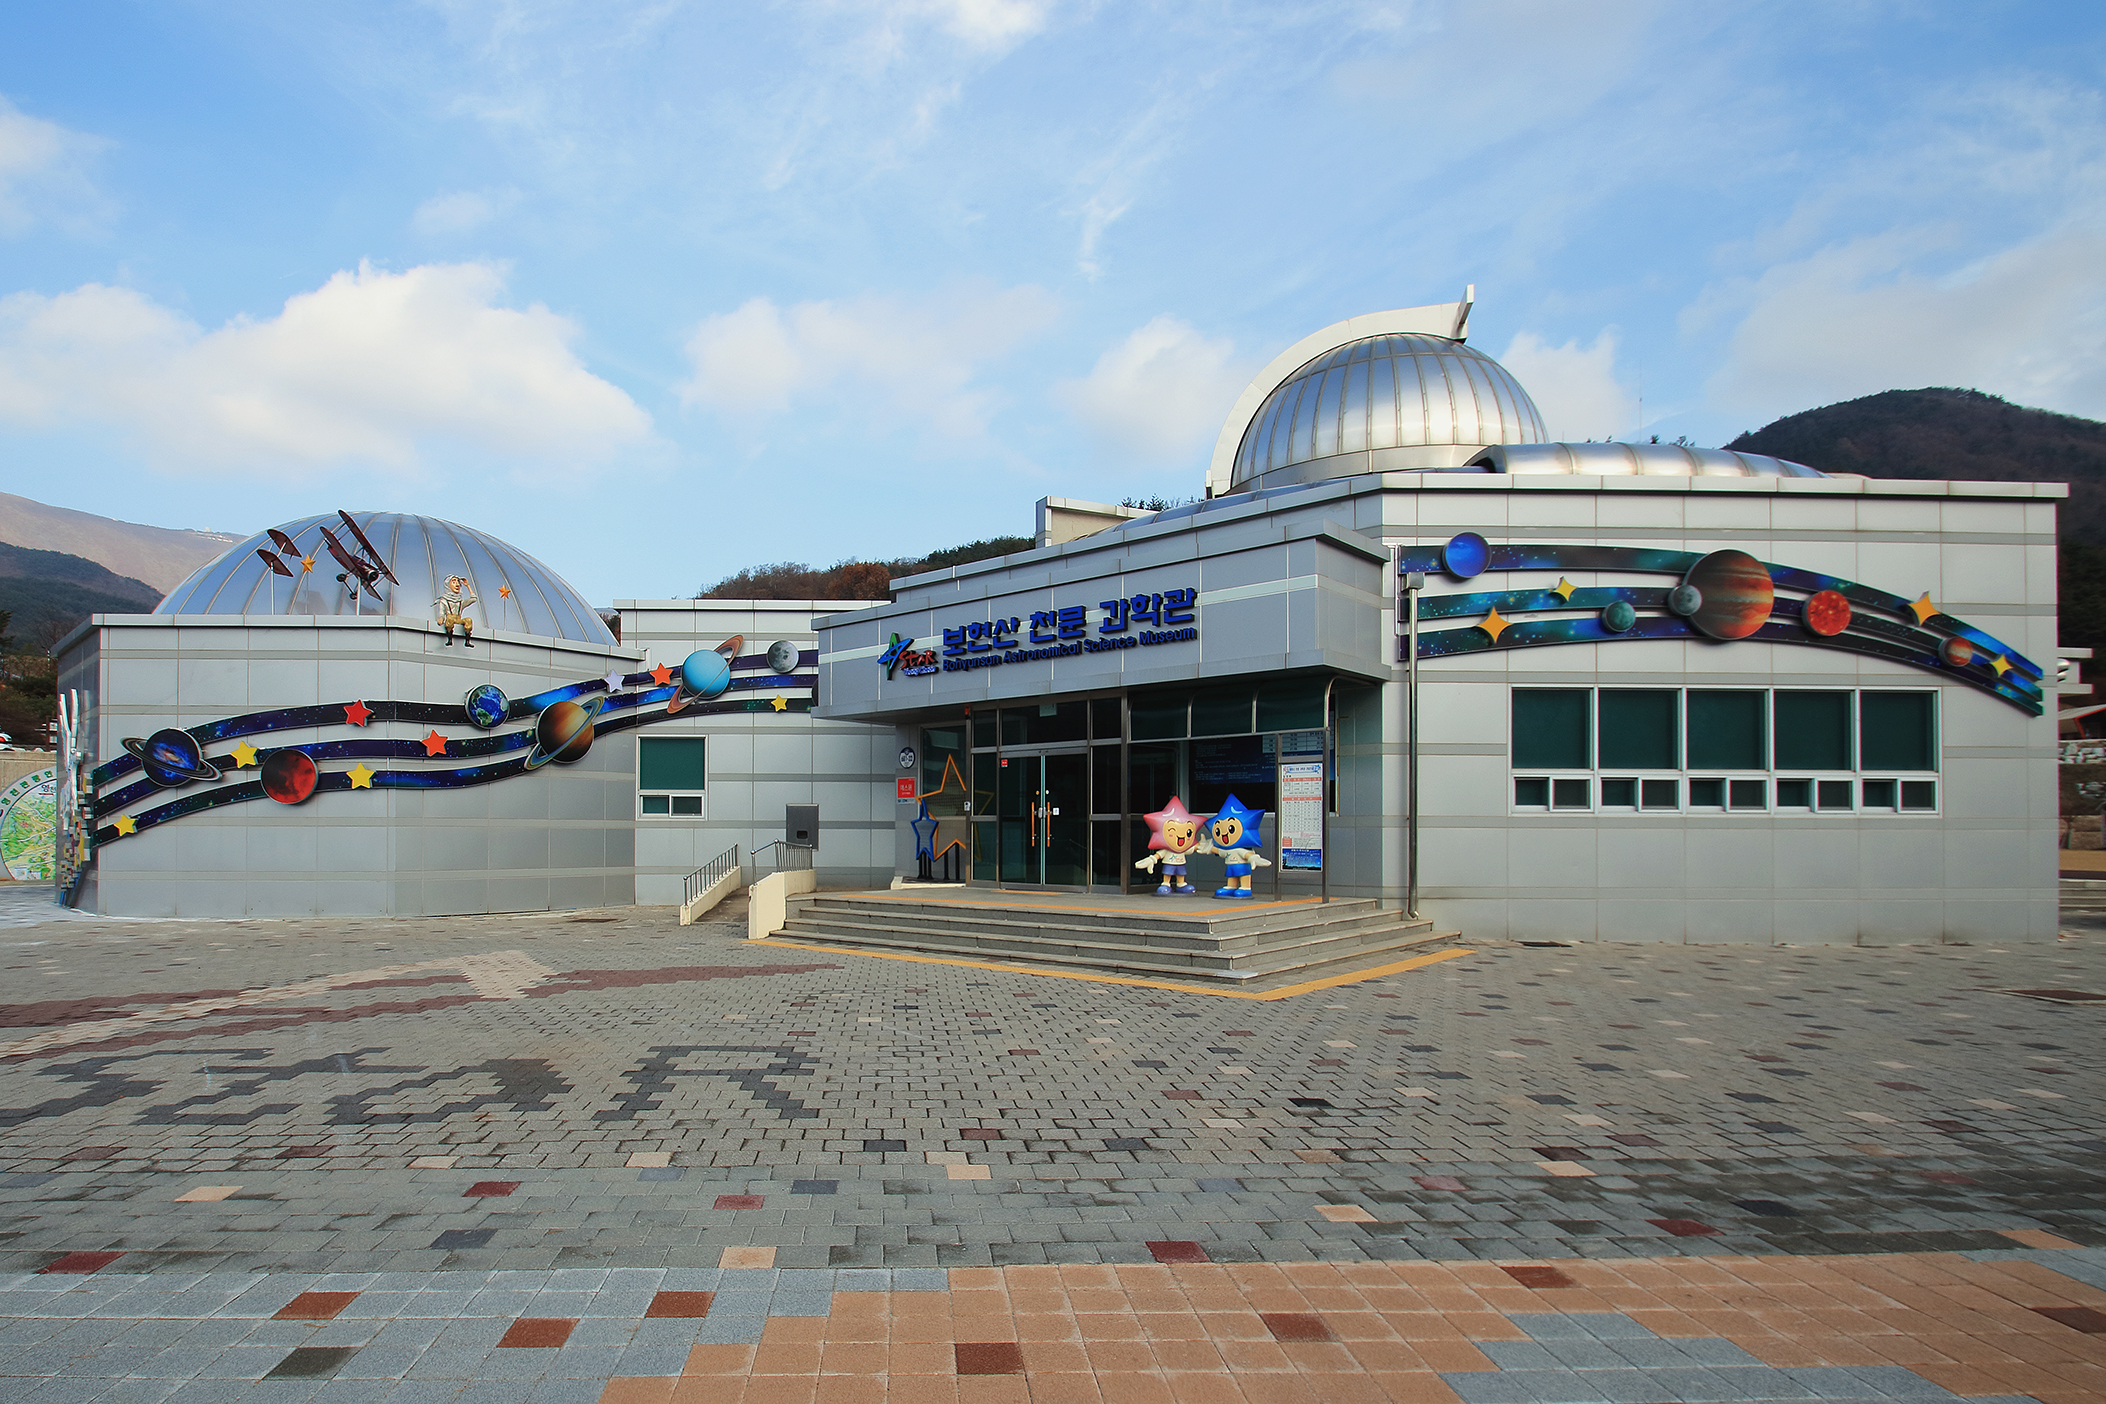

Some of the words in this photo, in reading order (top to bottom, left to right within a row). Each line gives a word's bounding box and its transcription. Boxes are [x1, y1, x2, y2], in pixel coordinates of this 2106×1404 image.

[942, 616, 1020, 656] 보현산
[1029, 605, 1087, 643] 천문
[1098, 587, 1198, 633] 과학관
[942, 654, 1002, 672] Bohyunsan
[1002, 643, 1081, 664] Astronomical
[1082, 634, 1135, 653] Science
[1138, 625, 1198, 647] Museum
